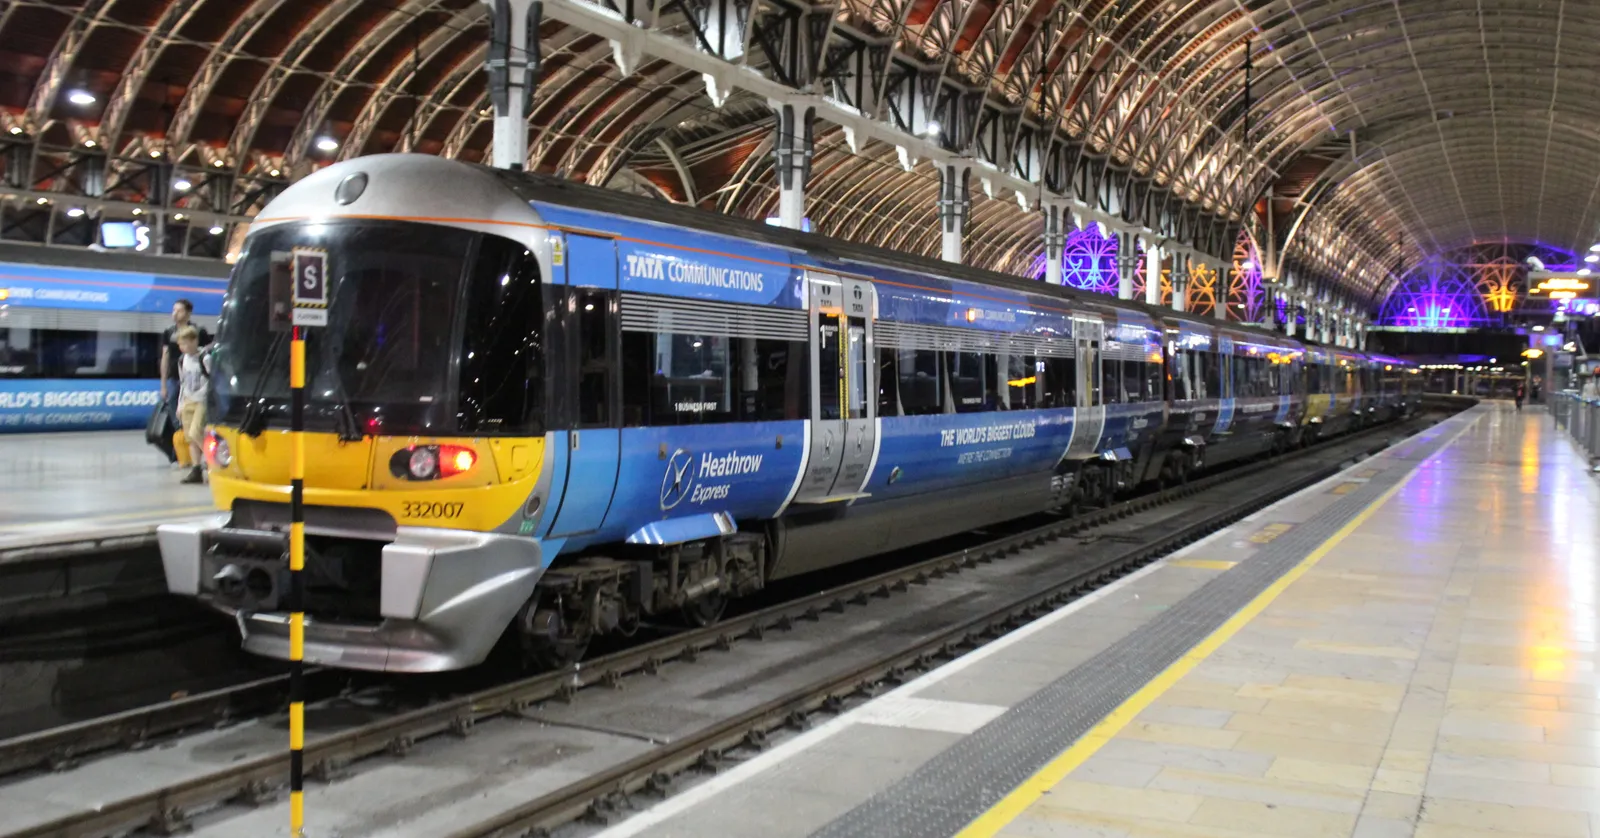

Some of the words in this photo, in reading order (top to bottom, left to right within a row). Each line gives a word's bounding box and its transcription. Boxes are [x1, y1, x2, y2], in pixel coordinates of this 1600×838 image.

[303, 264, 317, 290] S
[626, 254, 665, 281] TATA
[667, 261, 764, 292] COMMUNICATIONS
[852, 303, 864, 312] TATA
[43, 391, 104, 407] BIGGEST
[106, 390, 159, 406] CLOUDS
[679, 402, 702, 412] BUSINESS
[703, 402, 717, 411] FIRST
[45, 411, 112, 425] CONNECTION
[941, 429, 955, 447] THE
[956, 427, 987, 445] WORLD'S
[987, 424, 1014, 442] BIGGEST
[1013, 422, 1036, 439] CLOUDS
[699, 450, 763, 478] Heathrow
[690, 483, 731, 505] Express
[402, 500, 464, 519] 332007
